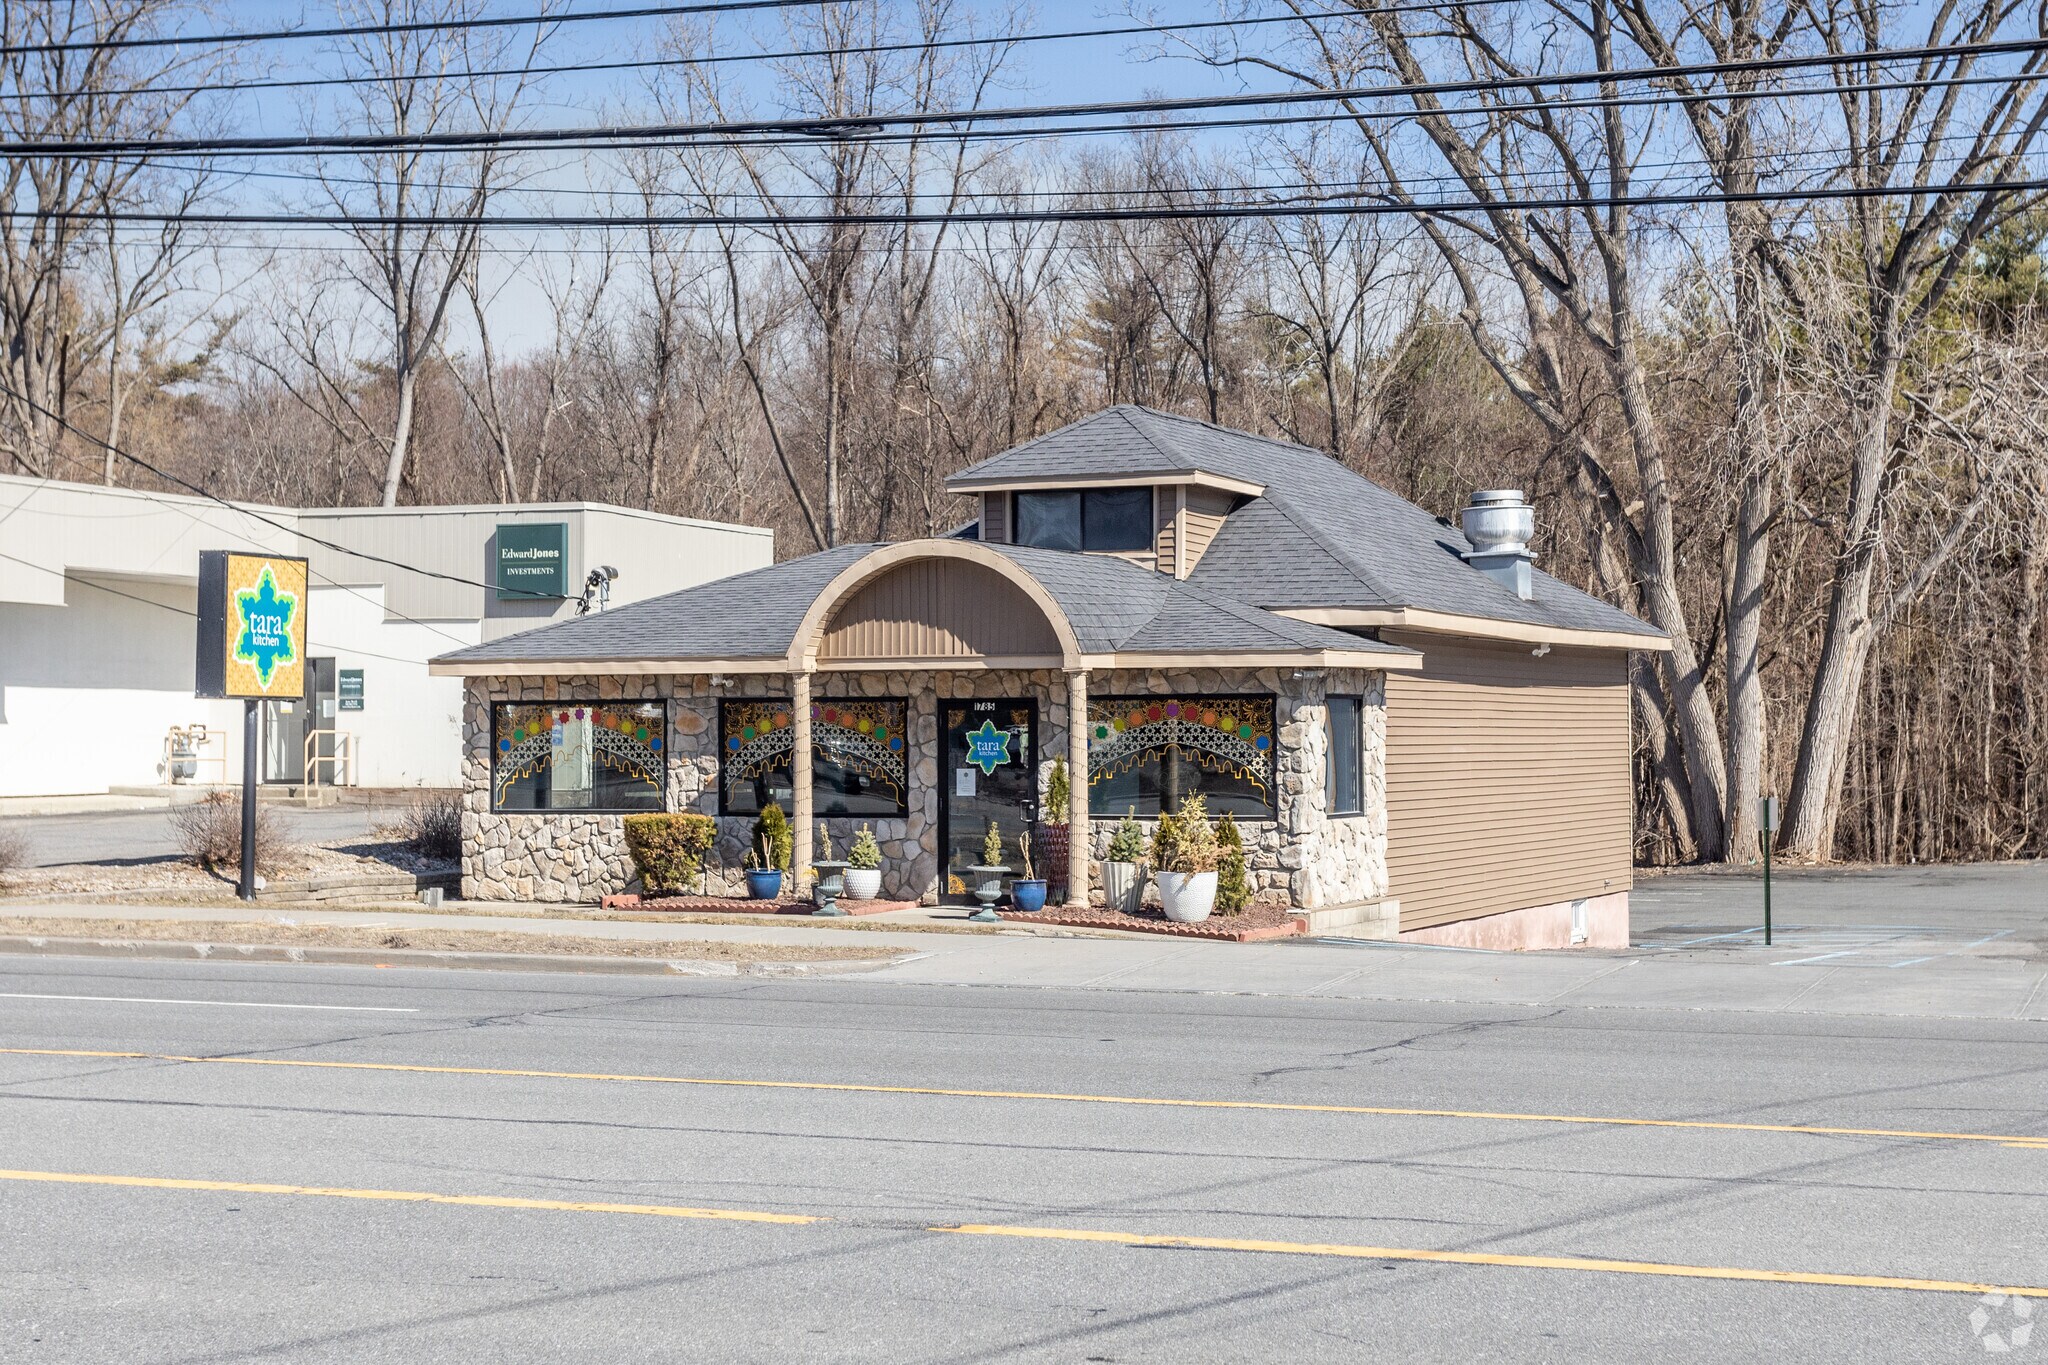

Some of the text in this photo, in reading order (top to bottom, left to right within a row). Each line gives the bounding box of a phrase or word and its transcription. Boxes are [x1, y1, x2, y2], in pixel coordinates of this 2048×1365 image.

[507, 567, 555, 576] INVESTMENTS
[249, 611, 283, 635] tara
[252, 633, 280, 647] kitchen
[974, 702, 995, 711] 1785
[977, 741, 1000, 751] tara
